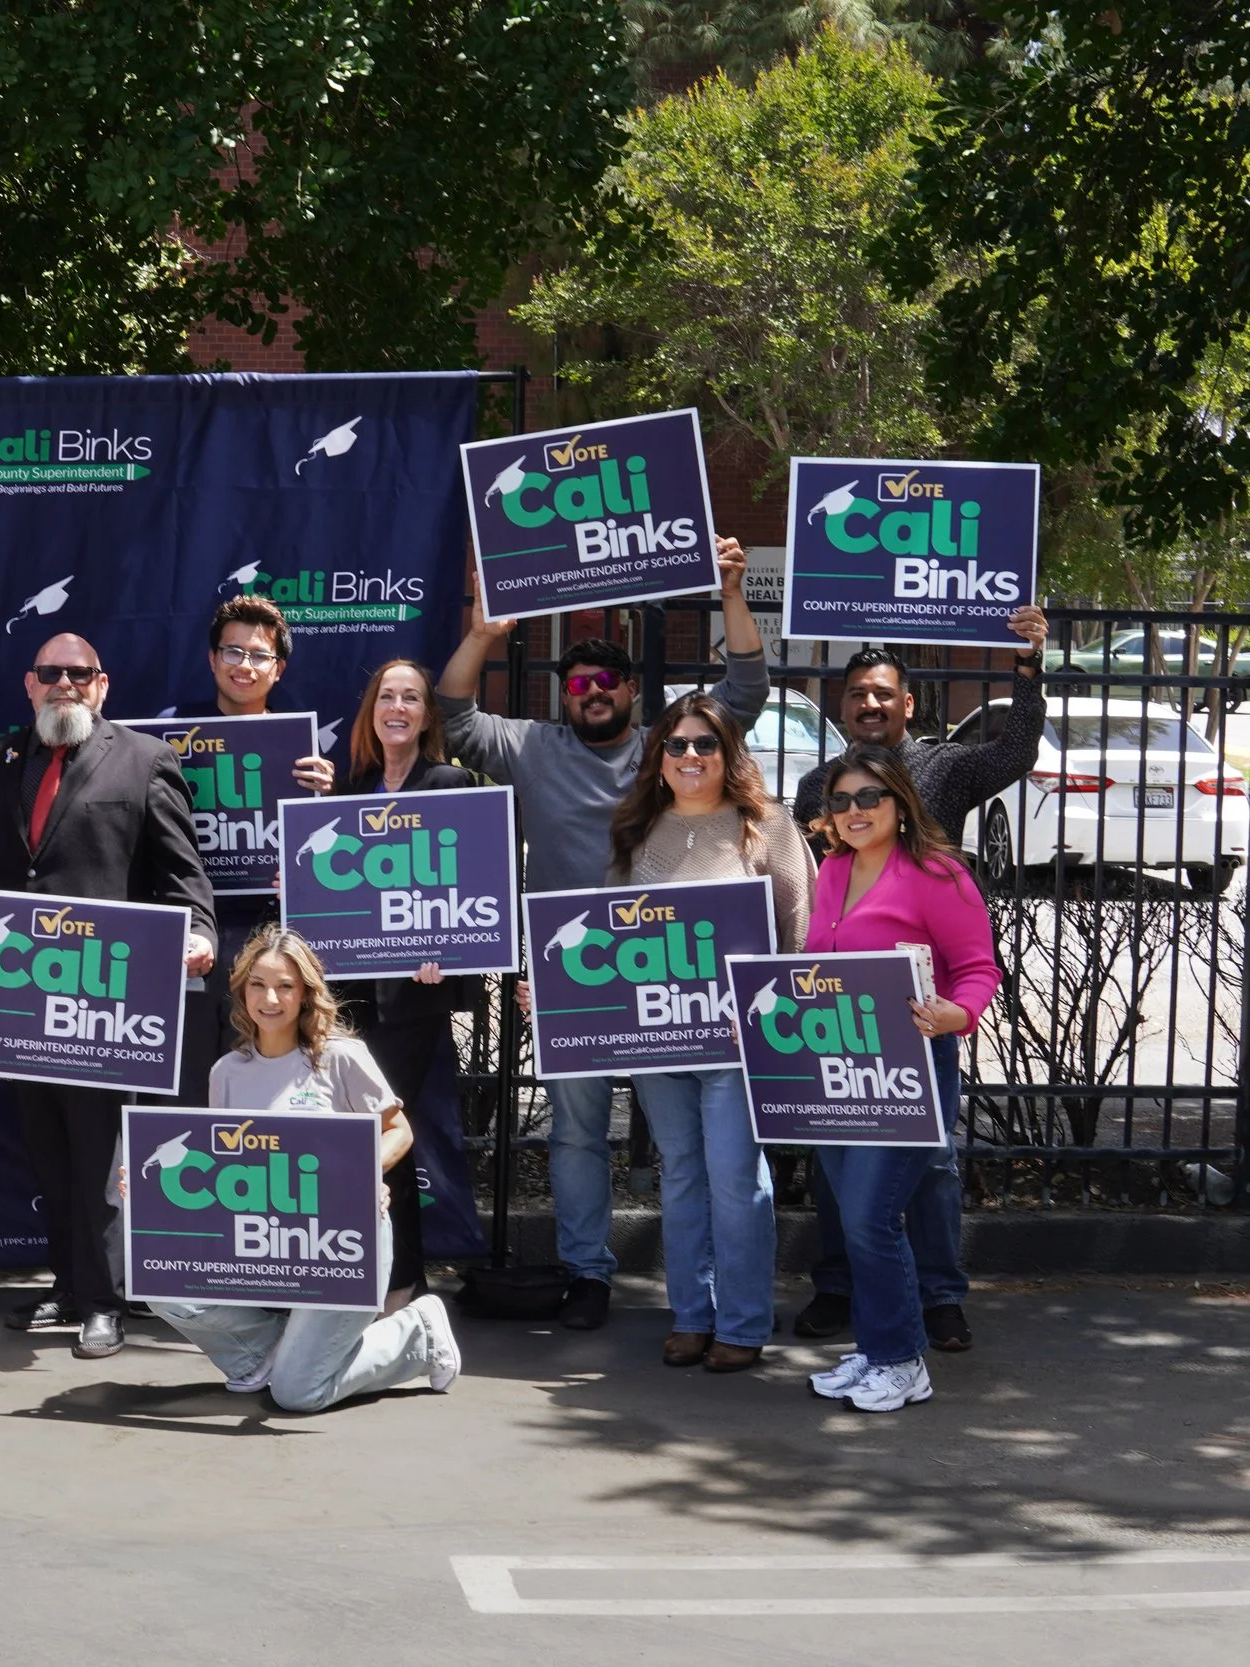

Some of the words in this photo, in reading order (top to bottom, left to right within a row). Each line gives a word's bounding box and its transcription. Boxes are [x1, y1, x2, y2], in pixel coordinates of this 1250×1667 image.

[58, 428, 152, 462] Binks
[32, 466, 124, 480] Superintendent
[48, 484, 66, 494] and
[68, 483, 88, 494] Bold
[89, 482, 124, 493] Futures
[501, 456, 651, 528] Cali
[574, 513, 698, 563] Binks
[825, 498, 981, 557] Cali
[242, 570, 326, 603] Cali
[332, 569, 424, 602] Binks
[496, 576, 540, 590] COUNTY
[541, 562, 633, 584] SUPERINTENDENT
[634, 560, 649, 570] OF
[651, 552, 701, 568] SCHOOLS
[746, 576, 773, 588] SAN
[894, 557, 1020, 602] Binks
[304, 606, 396, 621] Superintendent
[803, 600, 850, 611] COUNTY
[851, 602, 948, 615] SUPERINTENDENT
[950, 605, 965, 615] OF
[320, 624, 338, 634] and
[338, 624, 360, 634] Bold
[361, 622, 396, 632] Futures
[182, 753, 262, 810] ali
[191, 811, 278, 851] Bink
[241, 855, 256, 865] OF
[312, 828, 458, 891] Cali
[381, 888, 499, 931] Binks
[343, 935, 433, 949] SUPERINTENDENT
[435, 934, 449, 944] OF
[451, 932, 500, 944] SCHOOLS
[561, 921, 716, 986] Cali
[44, 995, 165, 1047] Binks
[636, 981, 734, 1026] Bink
[550, 1036, 597, 1048] COUNTY
[598, 1030, 694, 1045] SUPERINTENDENT
[696, 1028, 711, 1039] OF
[760, 994, 881, 1054] Cali
[4, 1037, 96, 1056] SUPERINTENDENT
[97, 1047, 112, 1058] OF
[113, 1049, 163, 1063] SCHOOLS
[819, 1056, 922, 1100] Binks
[761, 1104, 795, 1114] COUNTY
[796, 1104, 869, 1115] SUPERINTENDENT
[870, 1105, 883, 1115] OF
[884, 1105, 926, 1116] SCHOOLS
[160, 1150, 319, 1215] Cali
[4, 1237, 26, 1246] FPPC
[234, 1214, 364, 1262] Binks
[144, 1259, 191, 1271] COUNTY
[192, 1261, 291, 1276] SUPERINTENDENT
[293, 1266, 309, 1276] OF
[311, 1267, 364, 1279] SCHOOLS
